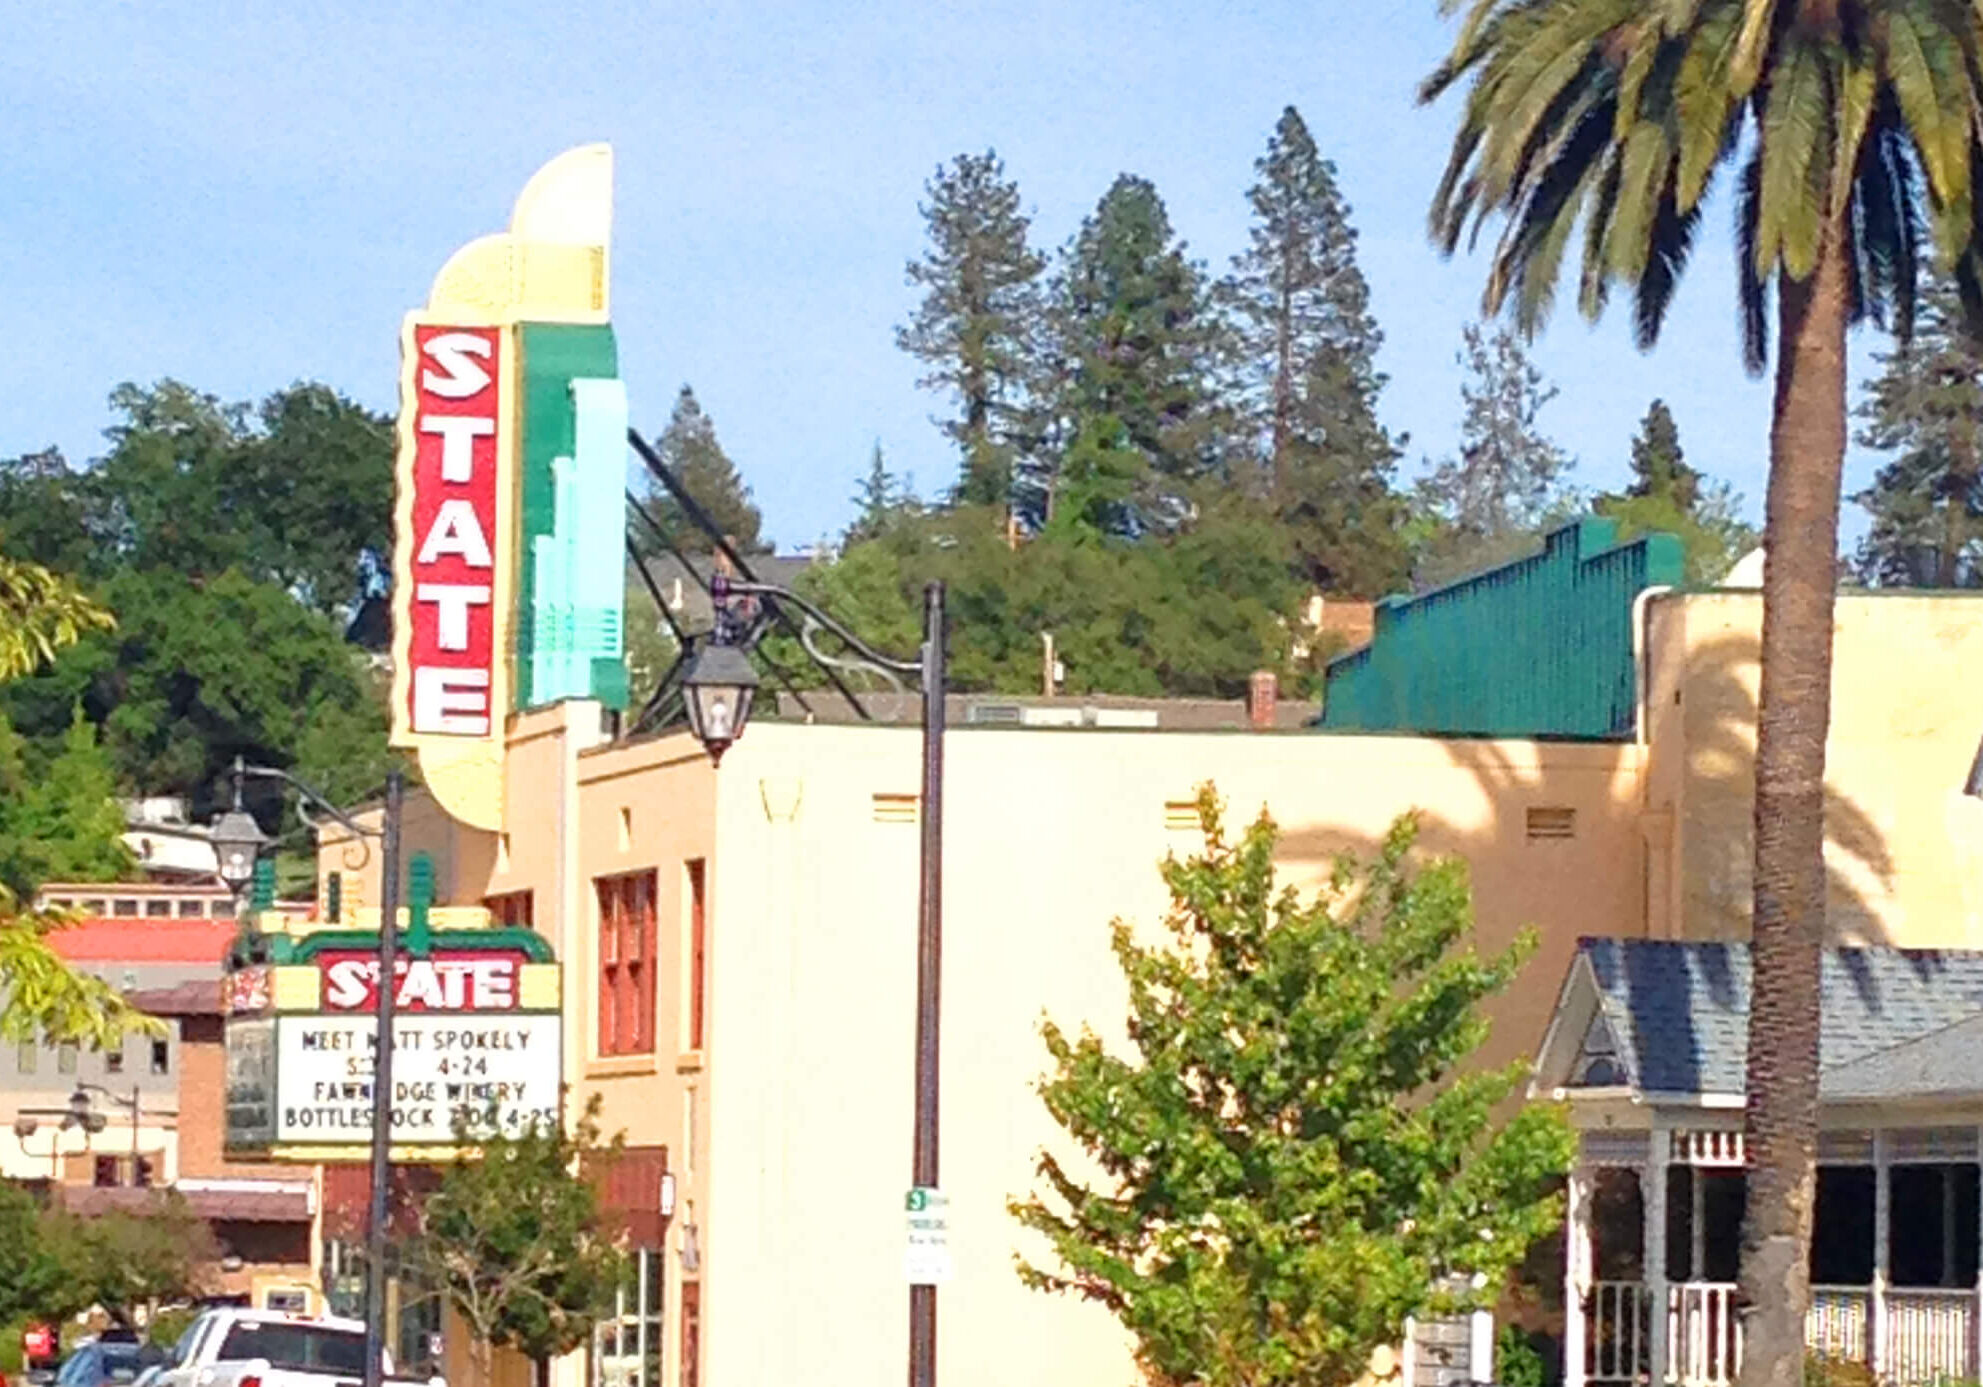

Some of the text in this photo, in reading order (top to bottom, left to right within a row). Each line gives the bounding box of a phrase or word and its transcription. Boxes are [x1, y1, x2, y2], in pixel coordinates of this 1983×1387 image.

[414, 333, 495, 736] STATE
[302, 1030, 531, 1050] MEET MTT SPOKELY
[437, 1056, 488, 1076] 4-24
[314, 1081, 527, 1102] FAWNDGE WINERY
[285, 1106, 434, 1128] BOTTLESOCK
